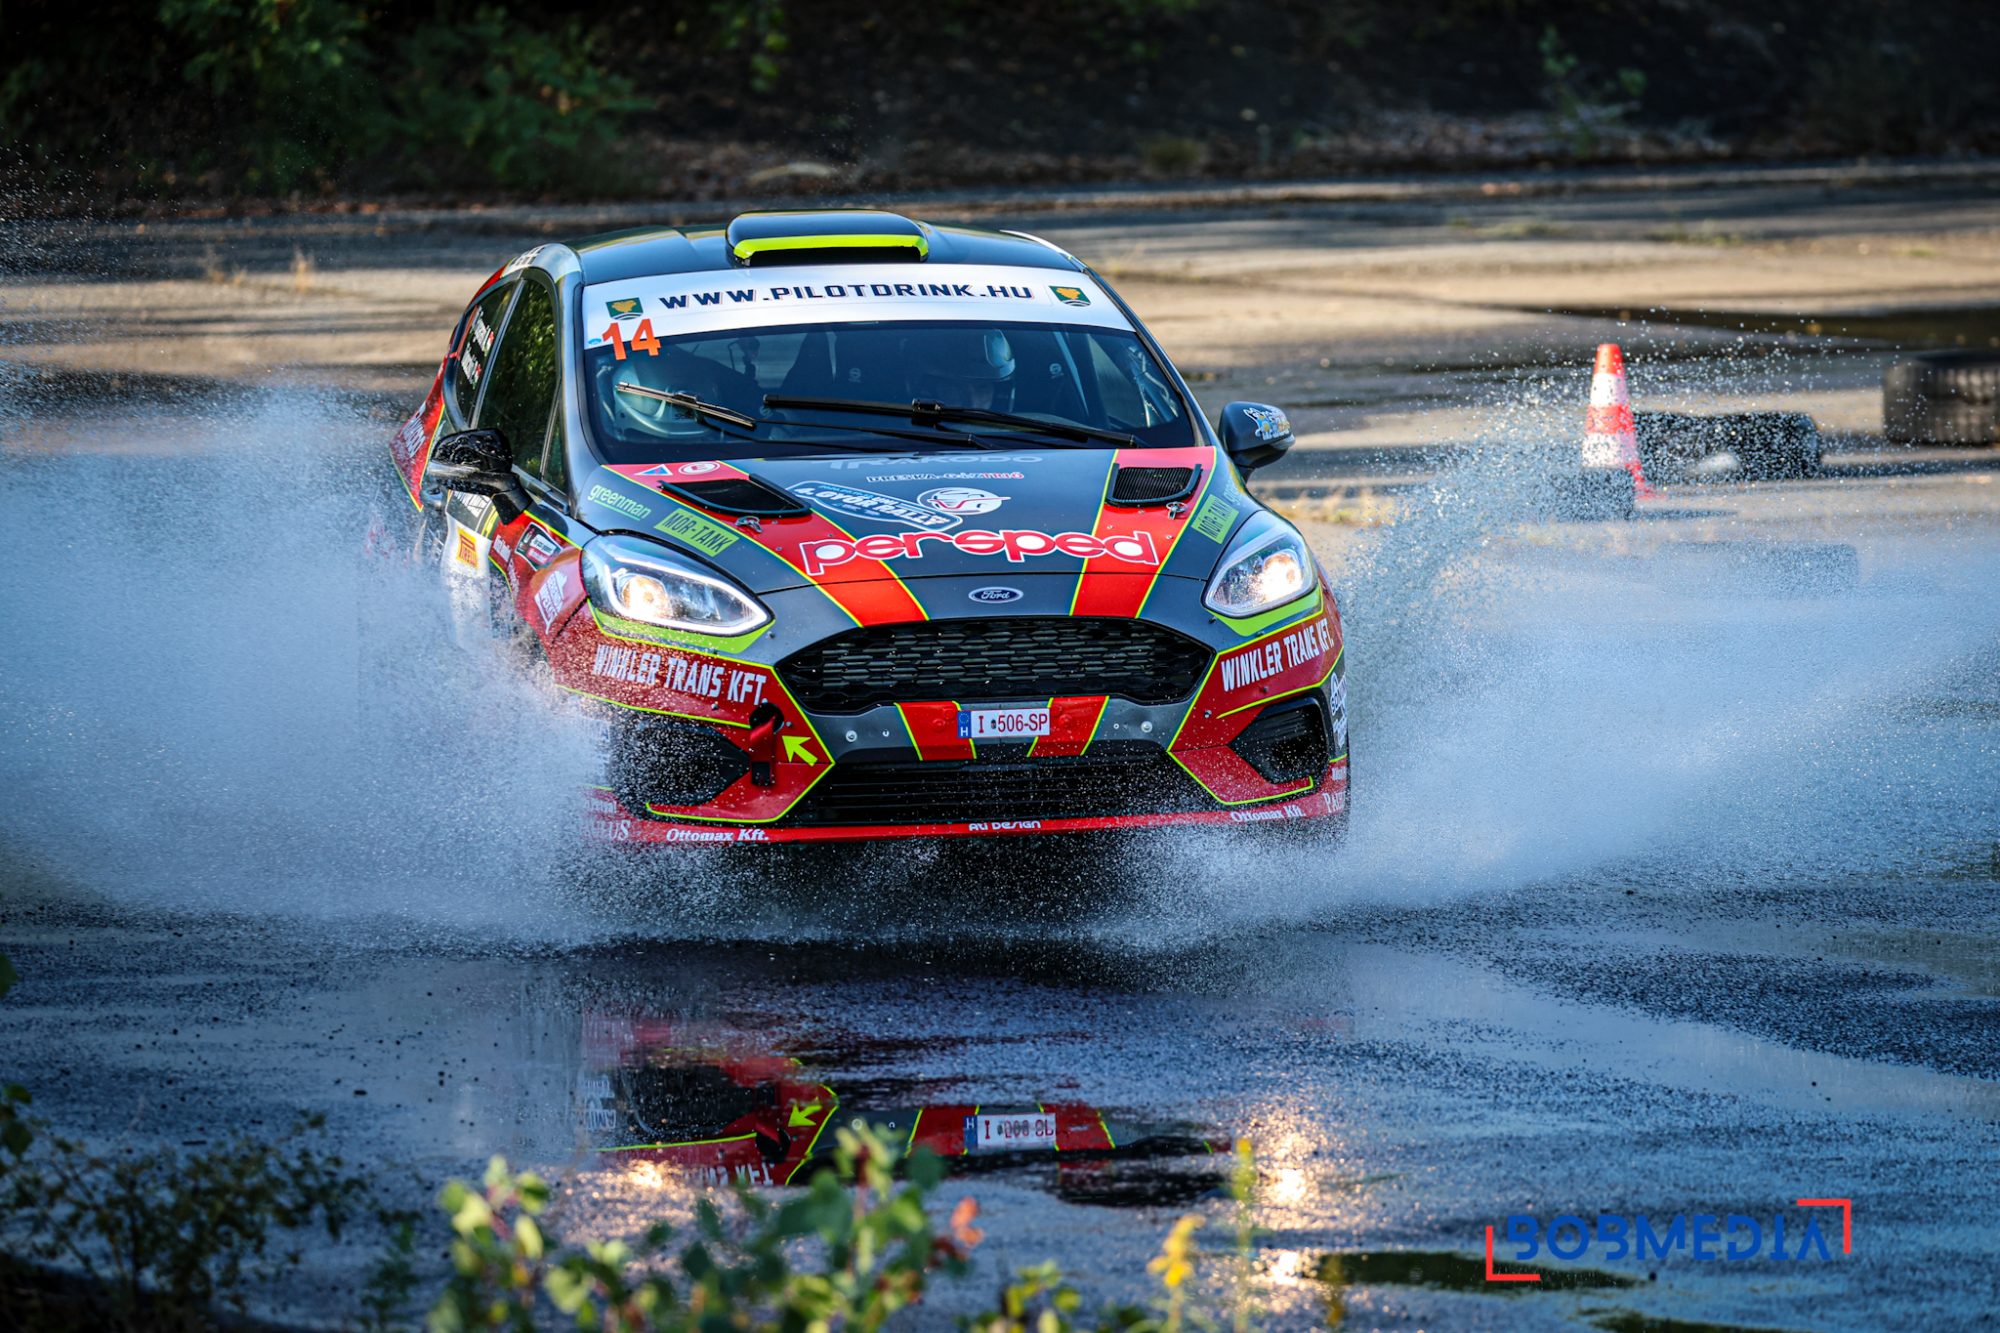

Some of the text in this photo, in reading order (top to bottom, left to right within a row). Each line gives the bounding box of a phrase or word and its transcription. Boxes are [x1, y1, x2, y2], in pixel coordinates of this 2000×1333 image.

[658, 283, 1033, 310] WWW.PILOTDRINK.HU
[602, 318, 662, 361] 14
[588, 484, 652, 520] greenman
[873, 504, 951, 526] RALLY
[799, 529, 1160, 576] persped
[981, 590, 1010, 600] Ford
[1221, 641, 1284, 693] WINKLER
[1283, 625, 1321, 669] TRANS
[592, 644, 769, 706] WINKLER TRANS KFT.
[960, 726, 969, 737] H
[666, 828, 770, 842] Ottomax Kft.
